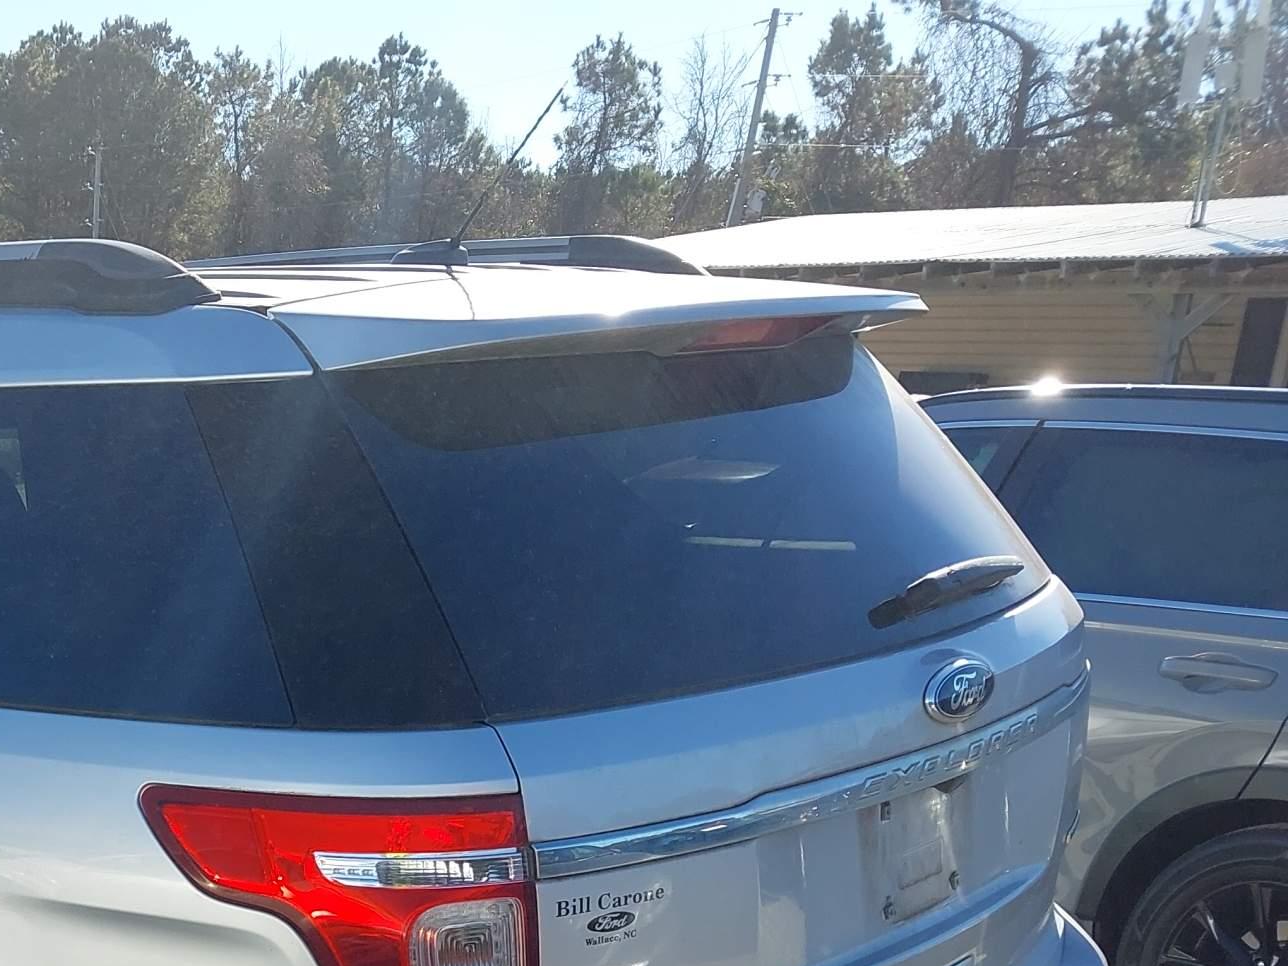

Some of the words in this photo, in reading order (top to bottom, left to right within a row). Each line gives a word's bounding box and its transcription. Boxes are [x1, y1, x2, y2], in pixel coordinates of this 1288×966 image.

[951, 671, 986, 711] Ford
[555, 896, 591, 918] Bill
[598, 887, 665, 910] Carone
[623, 929, 637, 940] NC
